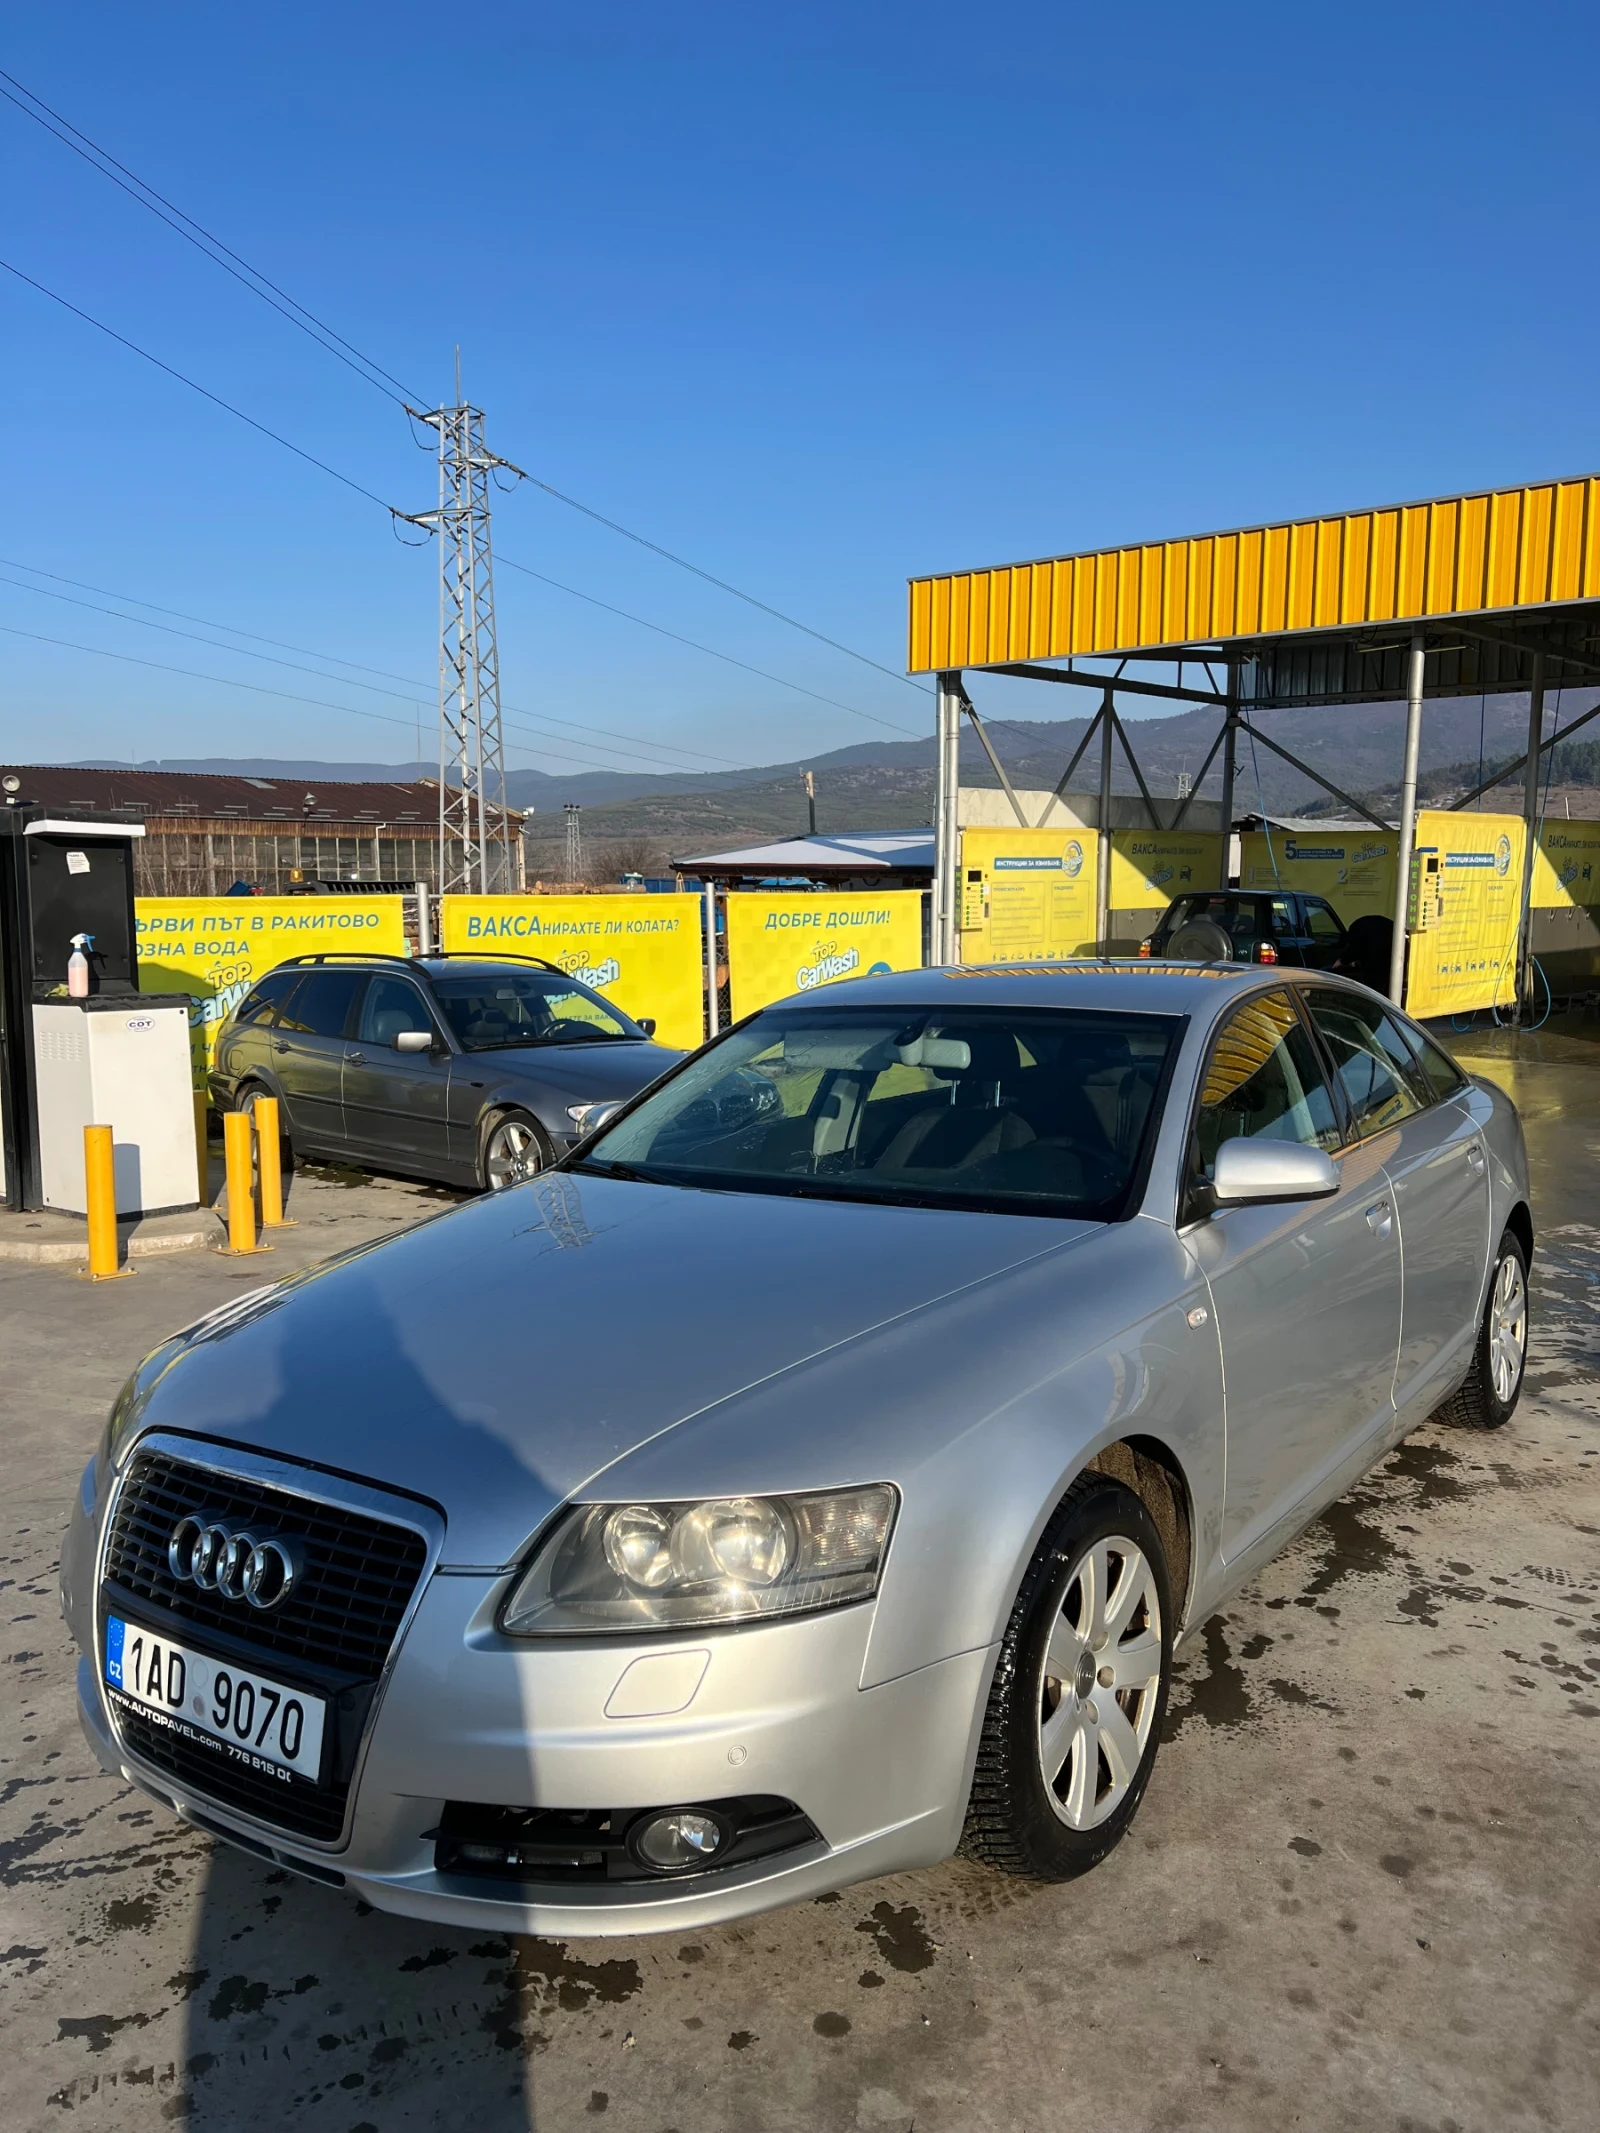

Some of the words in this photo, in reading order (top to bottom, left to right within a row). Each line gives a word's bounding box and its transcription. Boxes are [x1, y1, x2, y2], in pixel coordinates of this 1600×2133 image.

[135, 918, 195, 933] ЪРВИ
[202, 916, 245, 932] ПЪТ
[251, 916, 264, 931] В
[271, 914, 380, 930] РАКИТОВО
[604, 921, 622, 934] ЛИ
[626, 919, 680, 933] КОЛАТА?
[765, 912, 822, 930] ДОБРЕ
[825, 910, 891, 929] ДОШЛИ!
[136, 942, 186, 957] ОЗНА
[193, 940, 250, 957] ВОДА
[813, 941, 838, 962] TOP
[558, 950, 590, 973] TOP
[796, 947, 860, 990] CarWash
[208, 961, 252, 990] TOP
[569, 957, 620, 990] Wash
[189, 980, 252, 1028] CarW
[109, 1659, 122, 1680] CZ
[131, 1636, 186, 1708] 1AD
[212, 1671, 305, 1760] 9070
[227, 1744, 251, 1764] 776
[252, 1756, 275, 1776] 815
